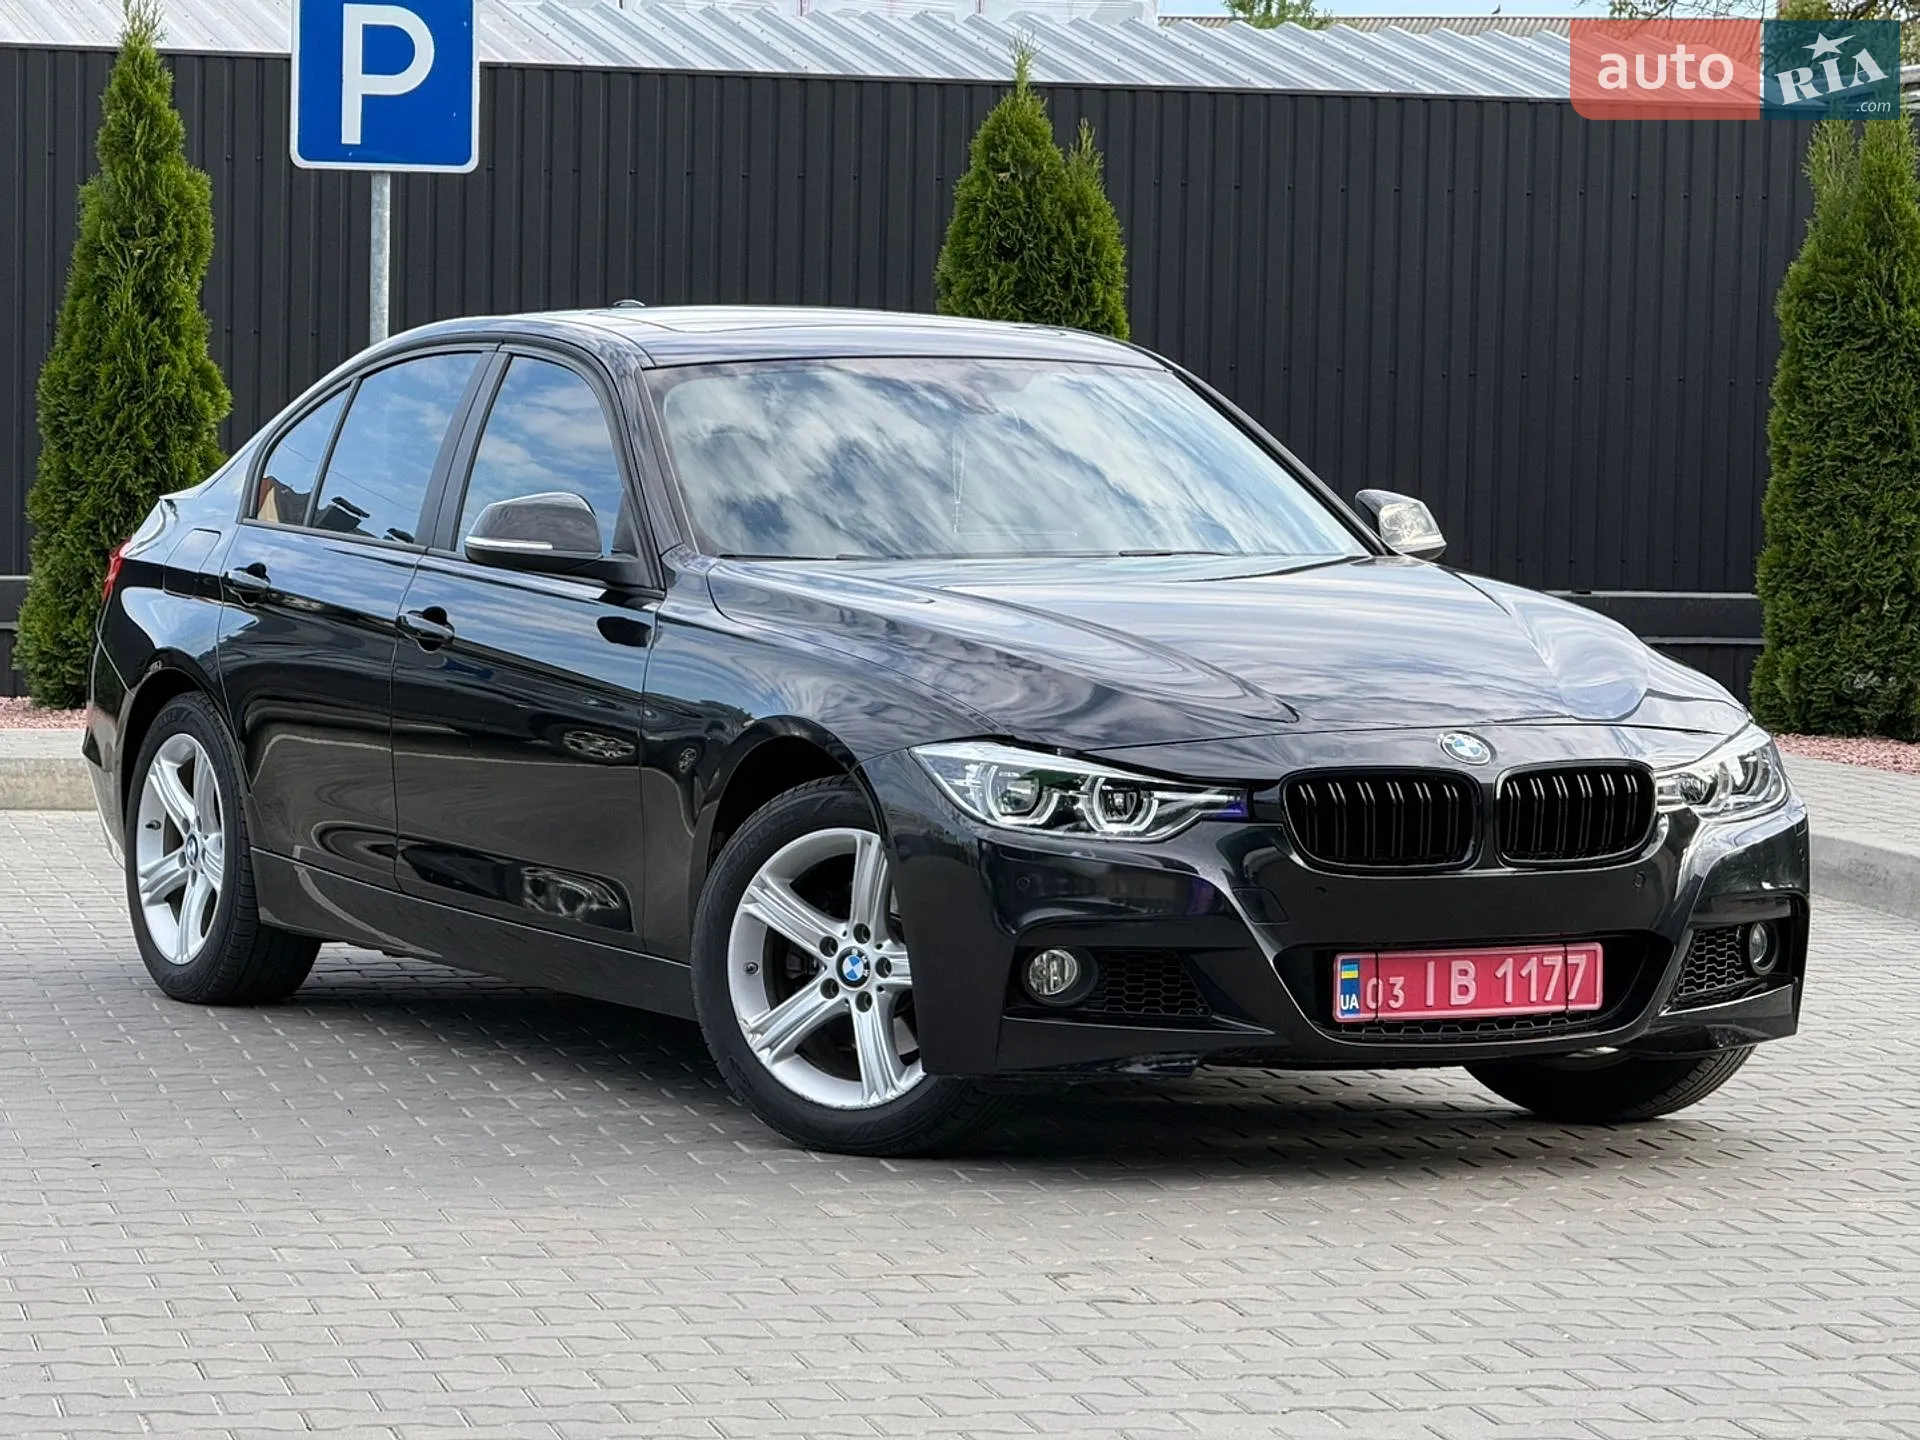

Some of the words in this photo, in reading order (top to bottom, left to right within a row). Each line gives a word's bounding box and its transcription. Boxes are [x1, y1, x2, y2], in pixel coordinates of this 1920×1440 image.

[341, 3, 435, 145] P
[1339, 993, 1360, 1011] UA
[1365, 976, 1406, 1010] 03
[1494, 953, 1588, 1004] 1177
